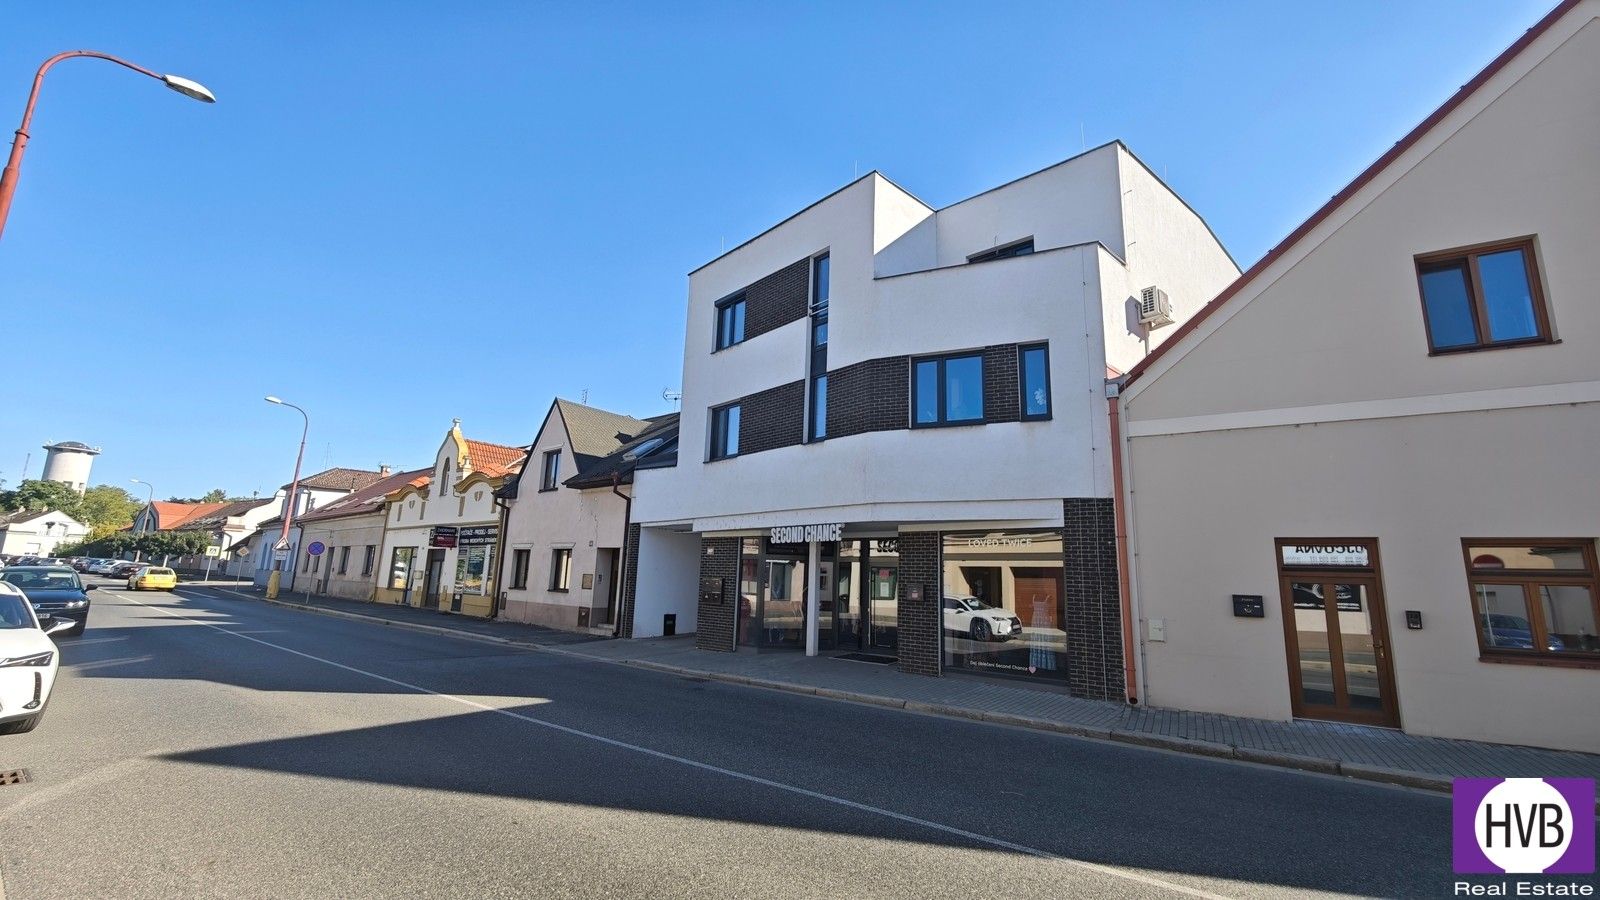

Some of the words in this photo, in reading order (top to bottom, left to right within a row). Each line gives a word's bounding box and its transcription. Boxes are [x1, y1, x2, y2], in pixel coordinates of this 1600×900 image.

[770, 526, 804, 544] SECOND
[804, 523, 842, 543] CHANCE
[968, 538, 999, 548] LOVED
[1001, 538, 1033, 548] TWICE
